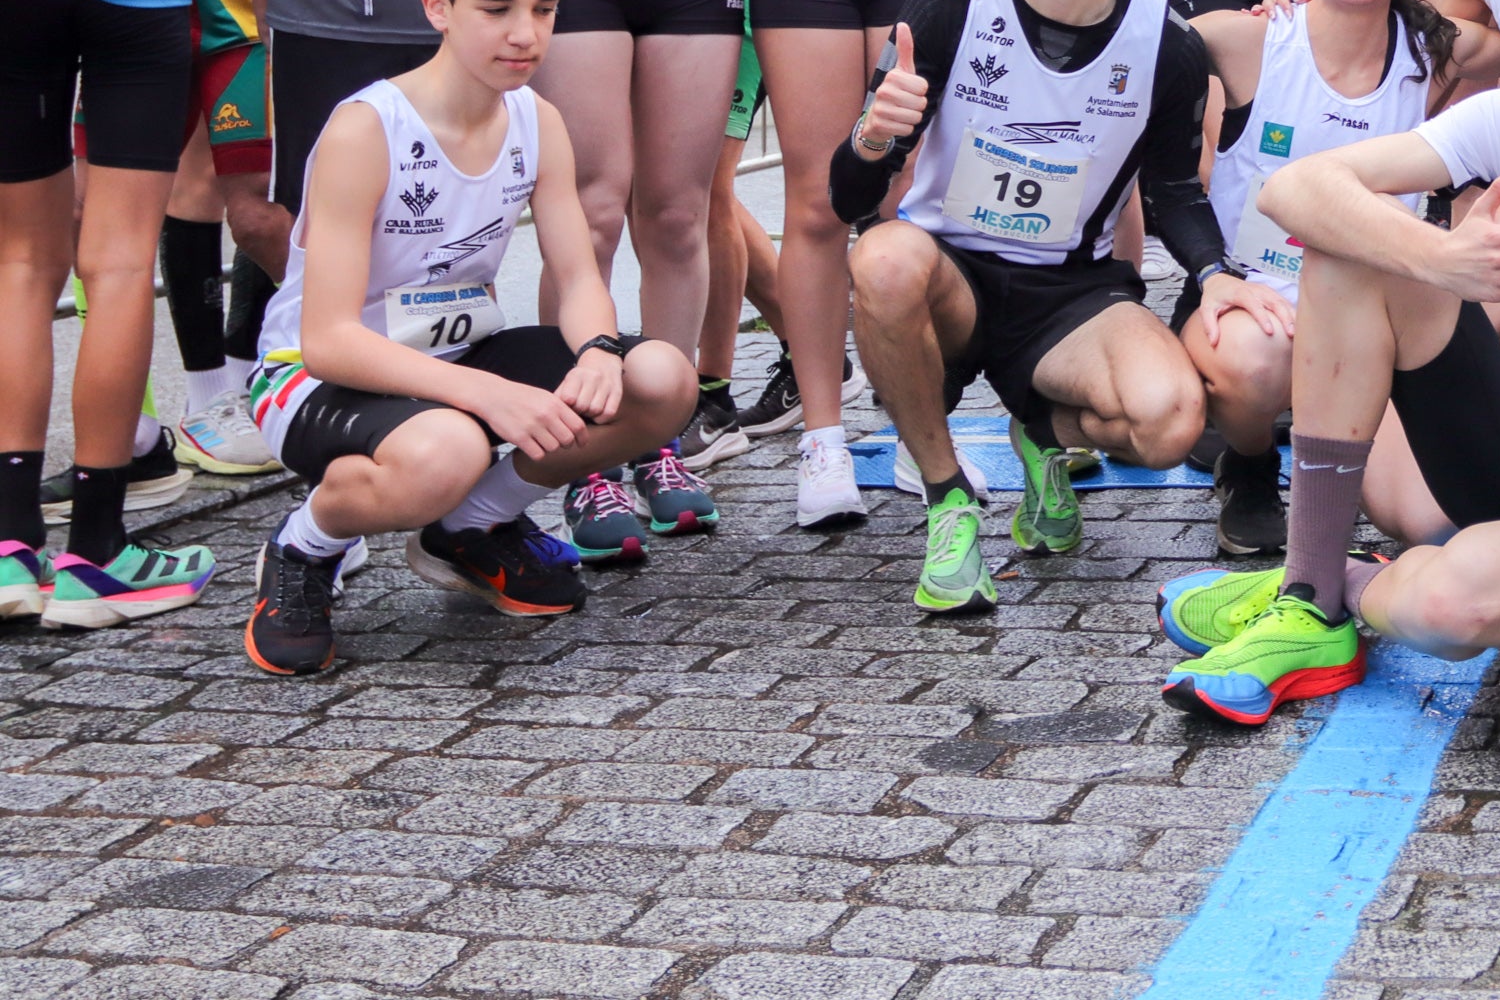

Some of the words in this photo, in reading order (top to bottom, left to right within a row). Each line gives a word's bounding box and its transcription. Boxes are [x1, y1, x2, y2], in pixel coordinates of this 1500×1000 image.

[975, 30, 1015, 47] VIATOR
[954, 91, 964, 100] DE
[966, 94, 1008, 112] SALAMANCA
[955, 83, 978, 97] CAJA
[980, 89, 1010, 105] RURAL
[1087, 96, 1139, 109] Ayuntamiento
[1085, 106, 1095, 115] de
[1097, 106, 1136, 118] Salamanca
[1341, 118, 1369, 131] rasán
[974, 137, 984, 150] III
[985, 142, 1027, 166] CARRERA
[976, 149, 1008, 169] Colegio
[400, 160, 438, 171] VIATOR
[993, 172, 1042, 208] 19
[385, 219, 411, 228] CAJA
[414, 218, 445, 228] RURAL
[970, 205, 1042, 234] HESAN
[398, 227, 444, 235] SALAMANCA
[1260, 248, 1303, 271] HES
[405, 306, 440, 317] Colegio
[430, 314, 472, 348] 10
